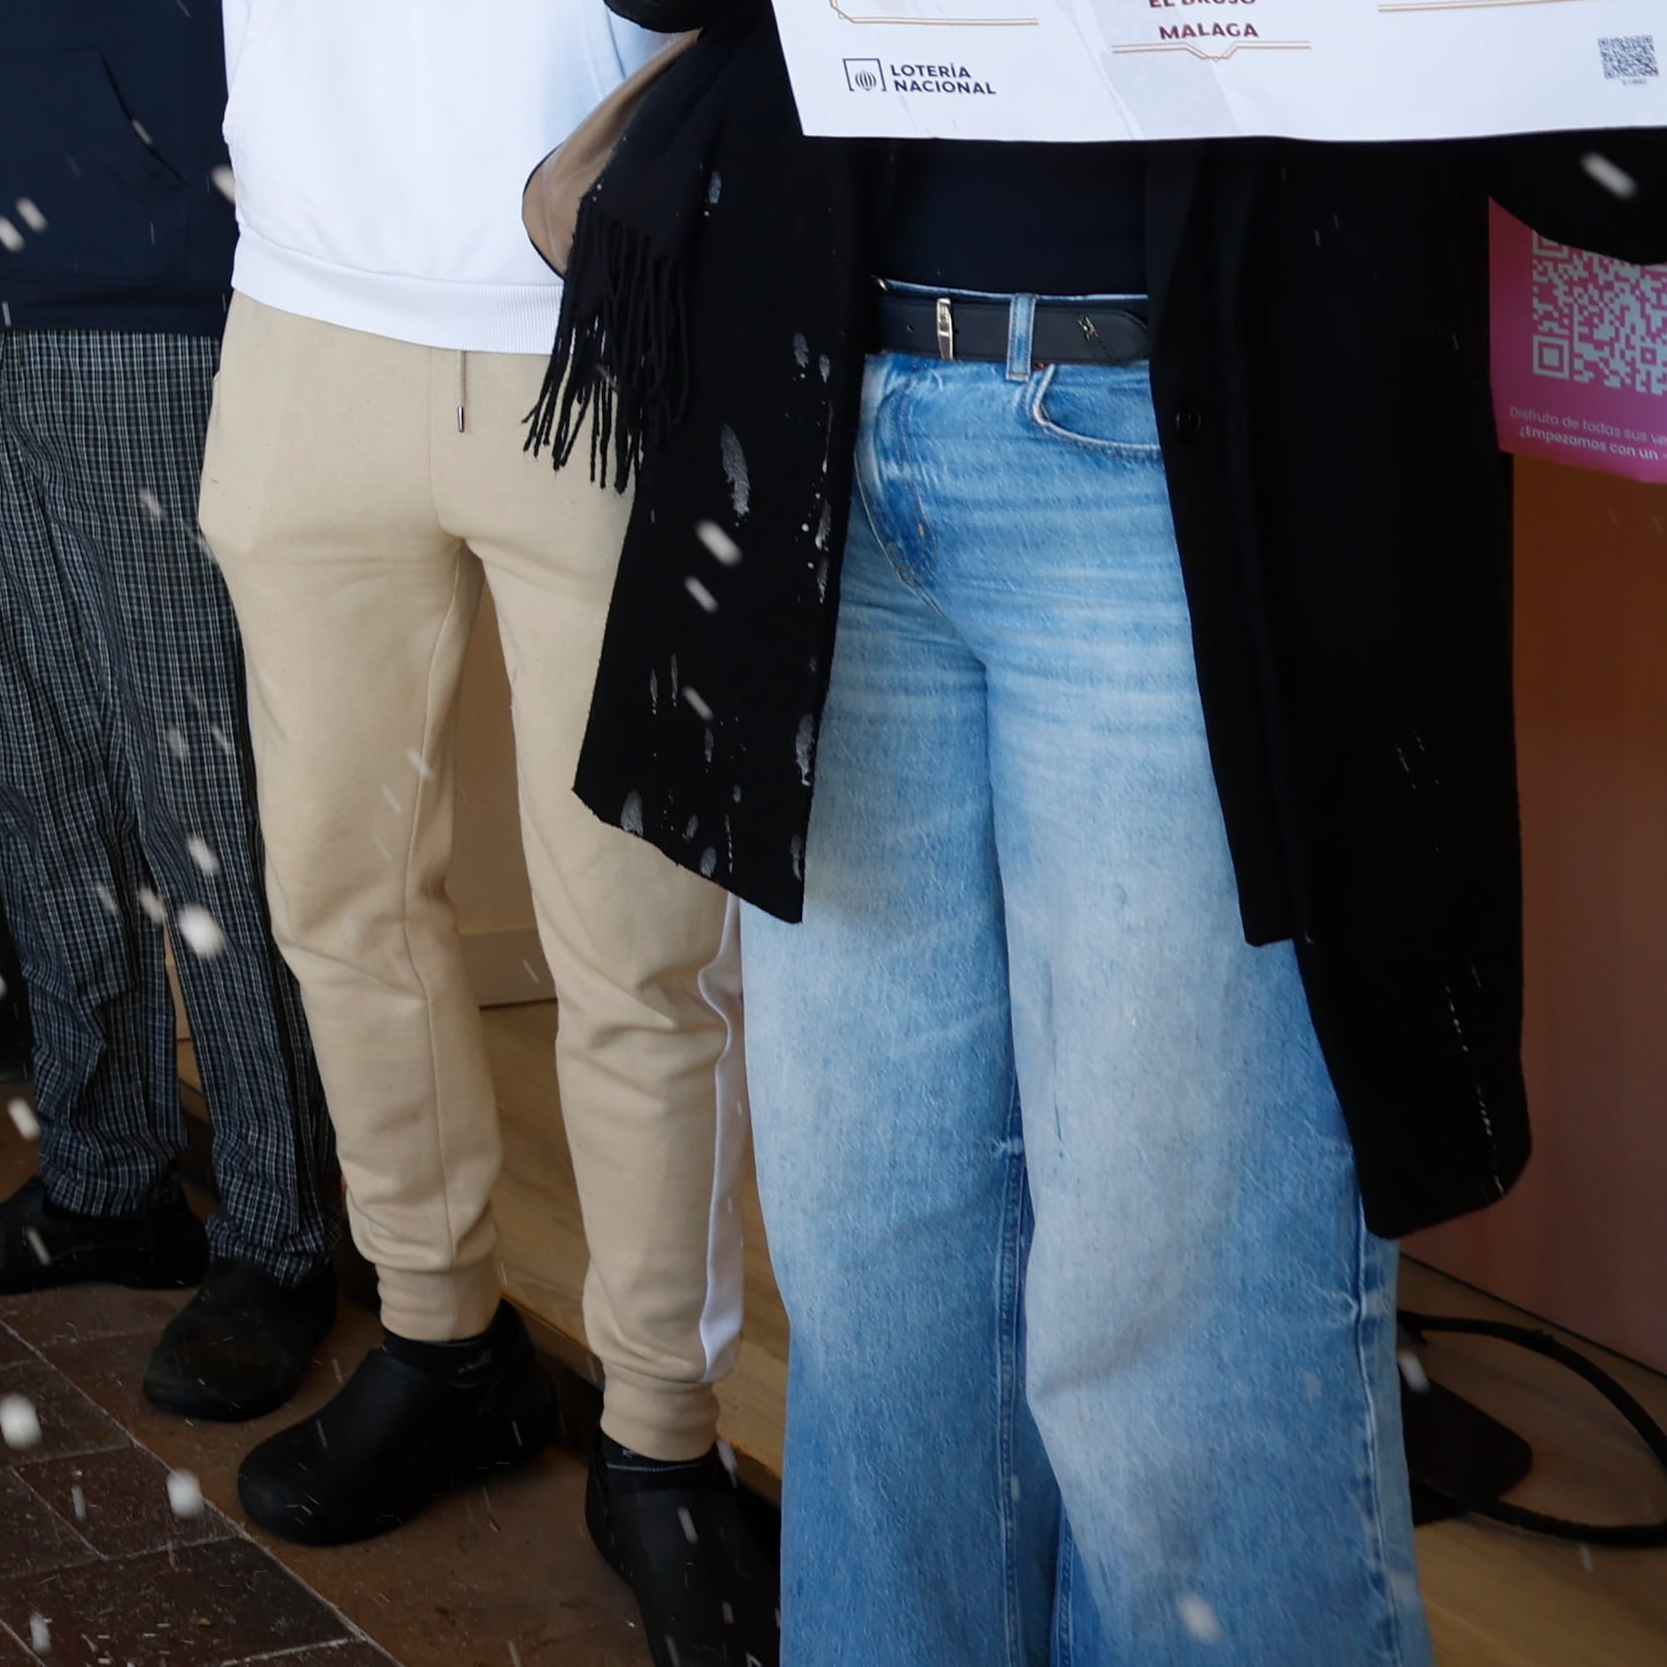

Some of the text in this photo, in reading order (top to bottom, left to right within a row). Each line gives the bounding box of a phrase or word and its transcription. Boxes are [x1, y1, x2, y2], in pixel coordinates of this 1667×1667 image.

[1159, 22, 1259, 40] MALAGA
[890, 62, 972, 80] LOTERÍA
[893, 79, 997, 96] NACIONAL
[1509, 405, 1559, 425] Disfruta
[1562, 414, 1579, 430] de
[1583, 417, 1622, 439] todas
[1625, 426, 1647, 440] sus
[1519, 424, 1659, 460] ¿Empezamos con un
